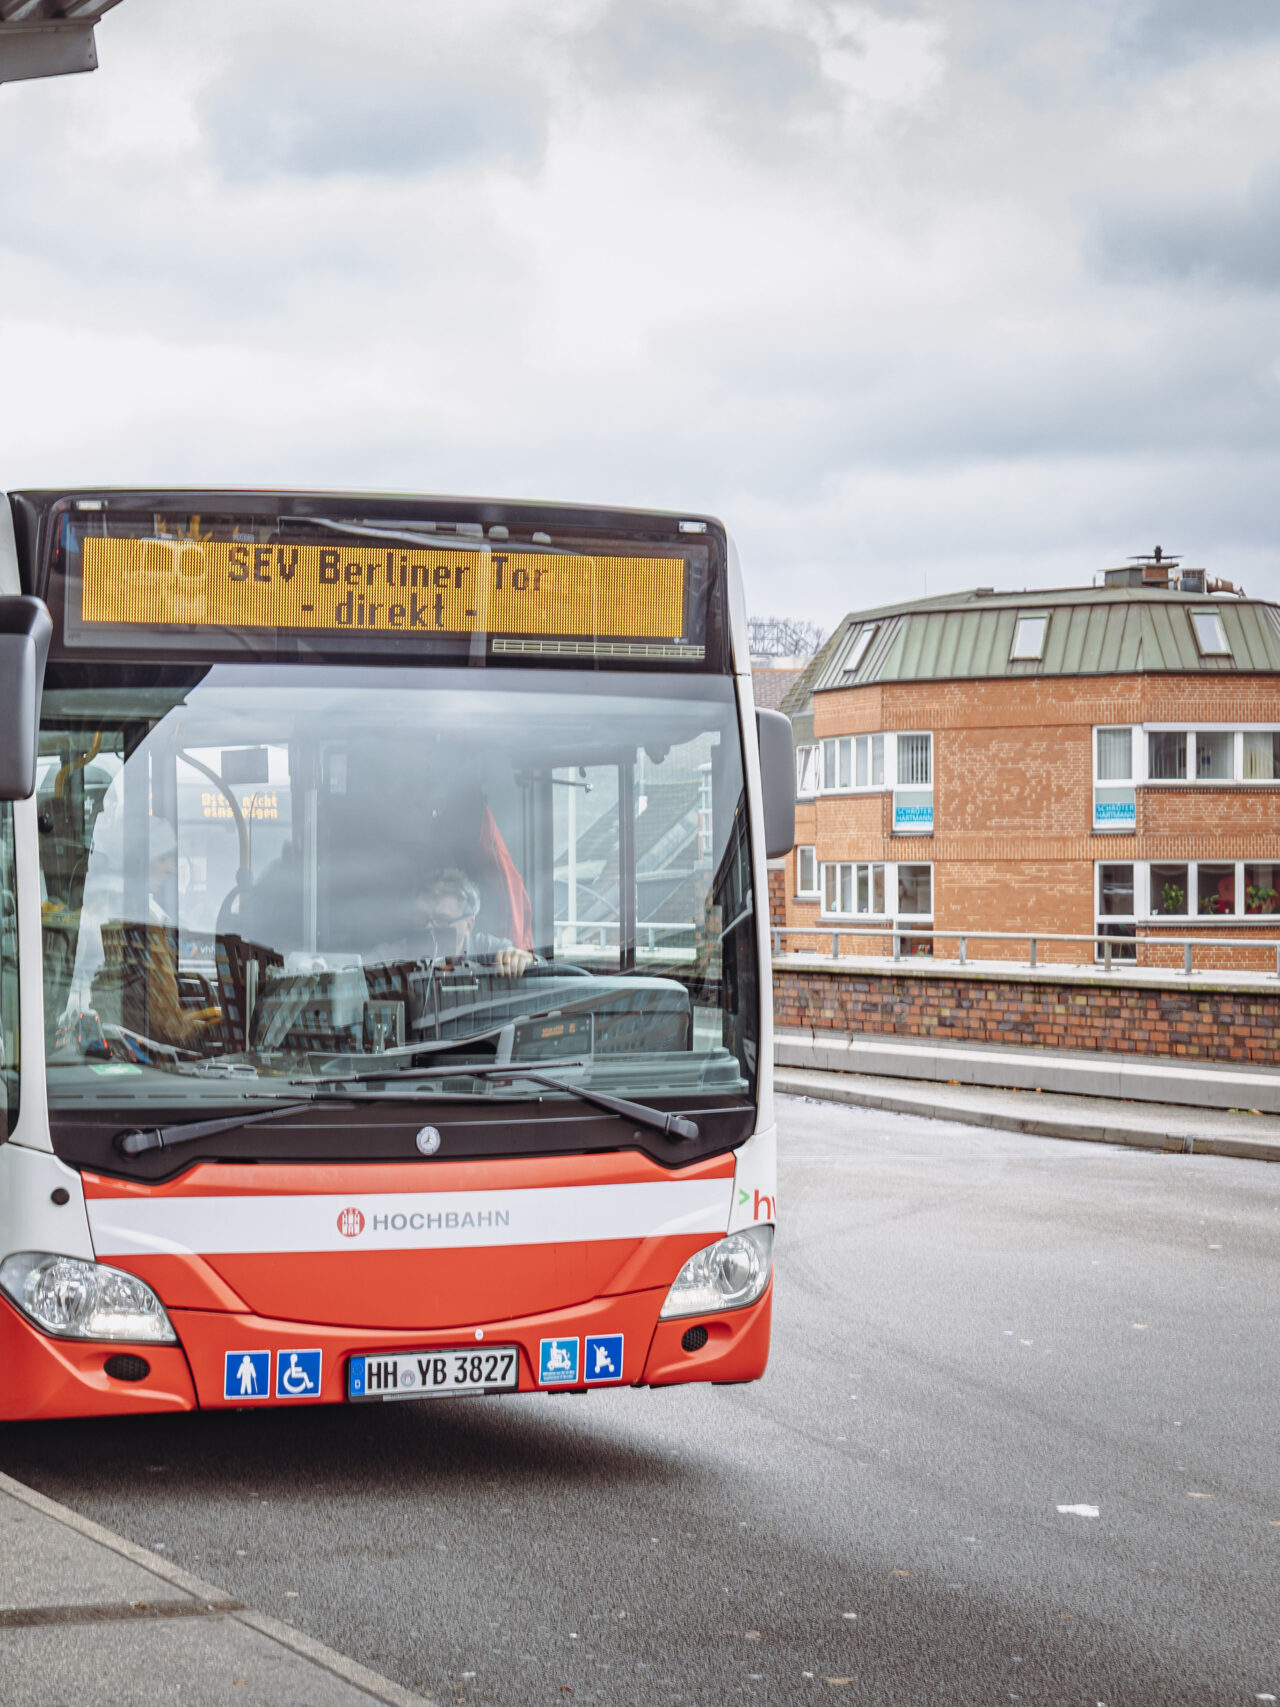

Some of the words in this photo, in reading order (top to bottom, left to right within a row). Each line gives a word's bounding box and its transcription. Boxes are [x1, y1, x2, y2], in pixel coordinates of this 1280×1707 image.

[228, 546, 299, 583] SEV
[319, 549, 471, 590] Berliner
[490, 555, 549, 592] Tor
[335, 590, 446, 628] direkt
[372, 1209, 510, 1231] HOCHBAHN
[367, 1361, 398, 1390] HH
[417, 1358, 448, 1387] YB
[453, 1353, 515, 1385] 3827
